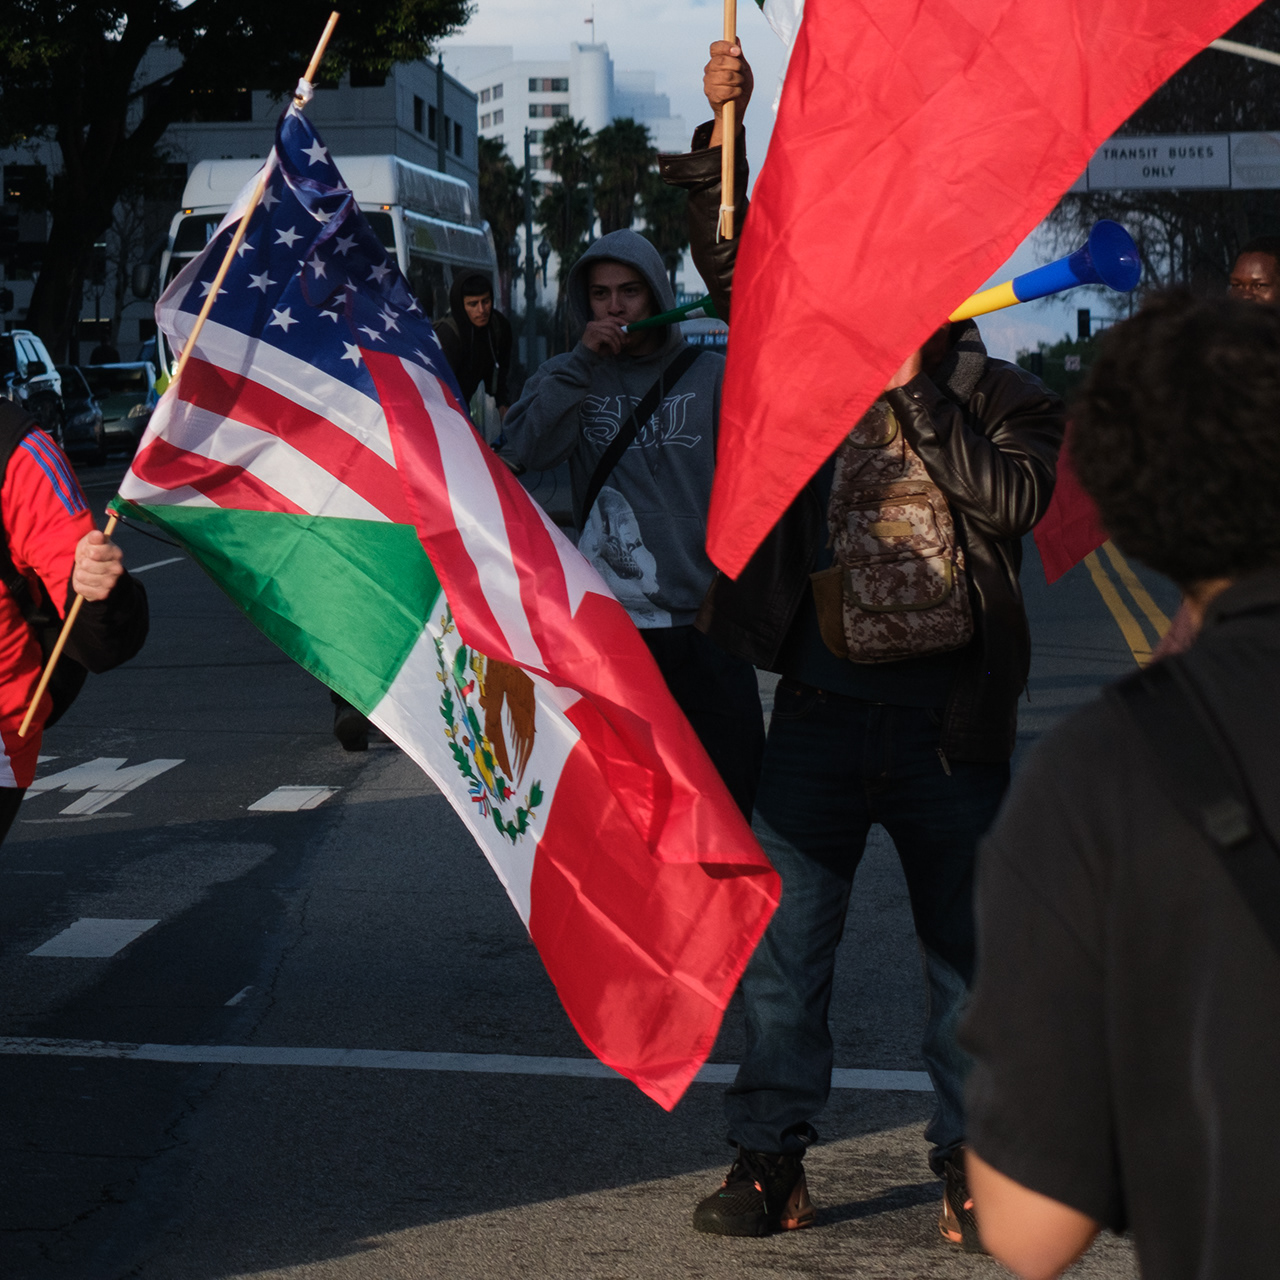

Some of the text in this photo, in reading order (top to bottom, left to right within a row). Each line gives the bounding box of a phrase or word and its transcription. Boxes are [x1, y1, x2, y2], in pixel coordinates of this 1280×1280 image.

[1103, 145, 1214, 161] TRANSIT BUSES
[1142, 166, 1176, 178] ONLY
